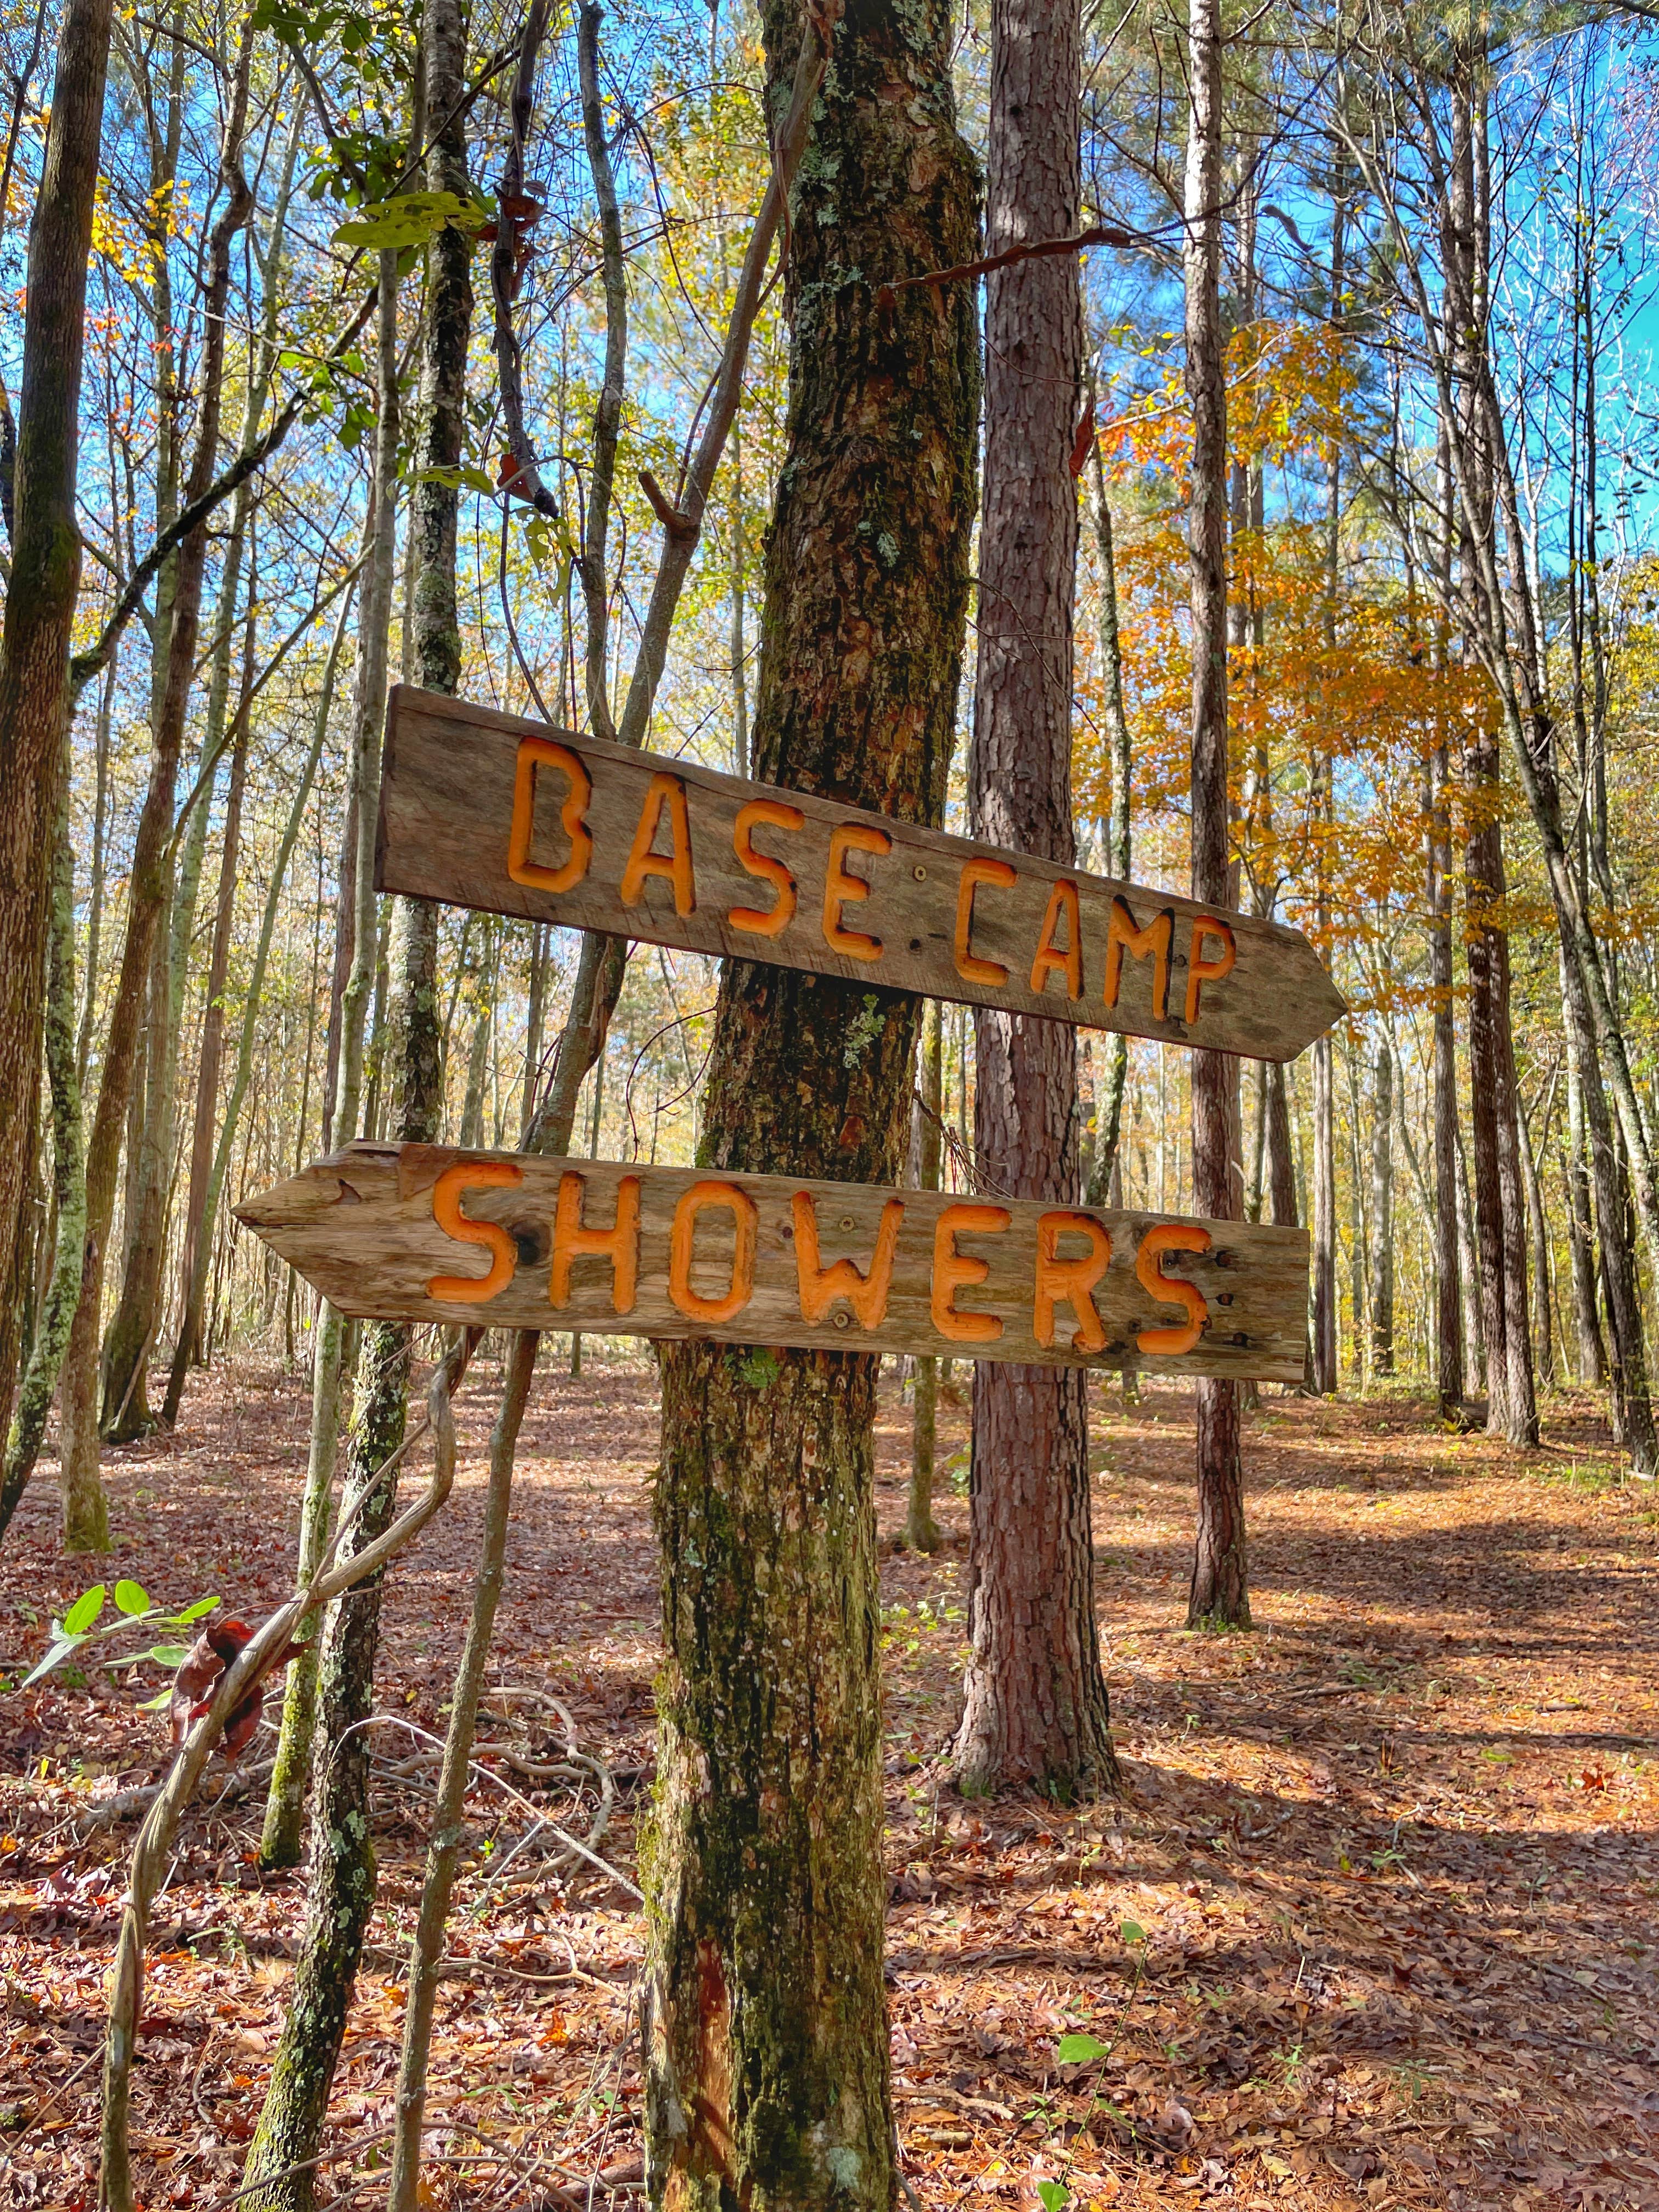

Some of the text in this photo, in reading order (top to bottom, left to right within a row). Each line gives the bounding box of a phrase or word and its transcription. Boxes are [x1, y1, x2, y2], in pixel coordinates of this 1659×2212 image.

[508, 736, 1236, 1024] BASE CAMP
[427, 1162, 1211, 1356] SHOWERS
